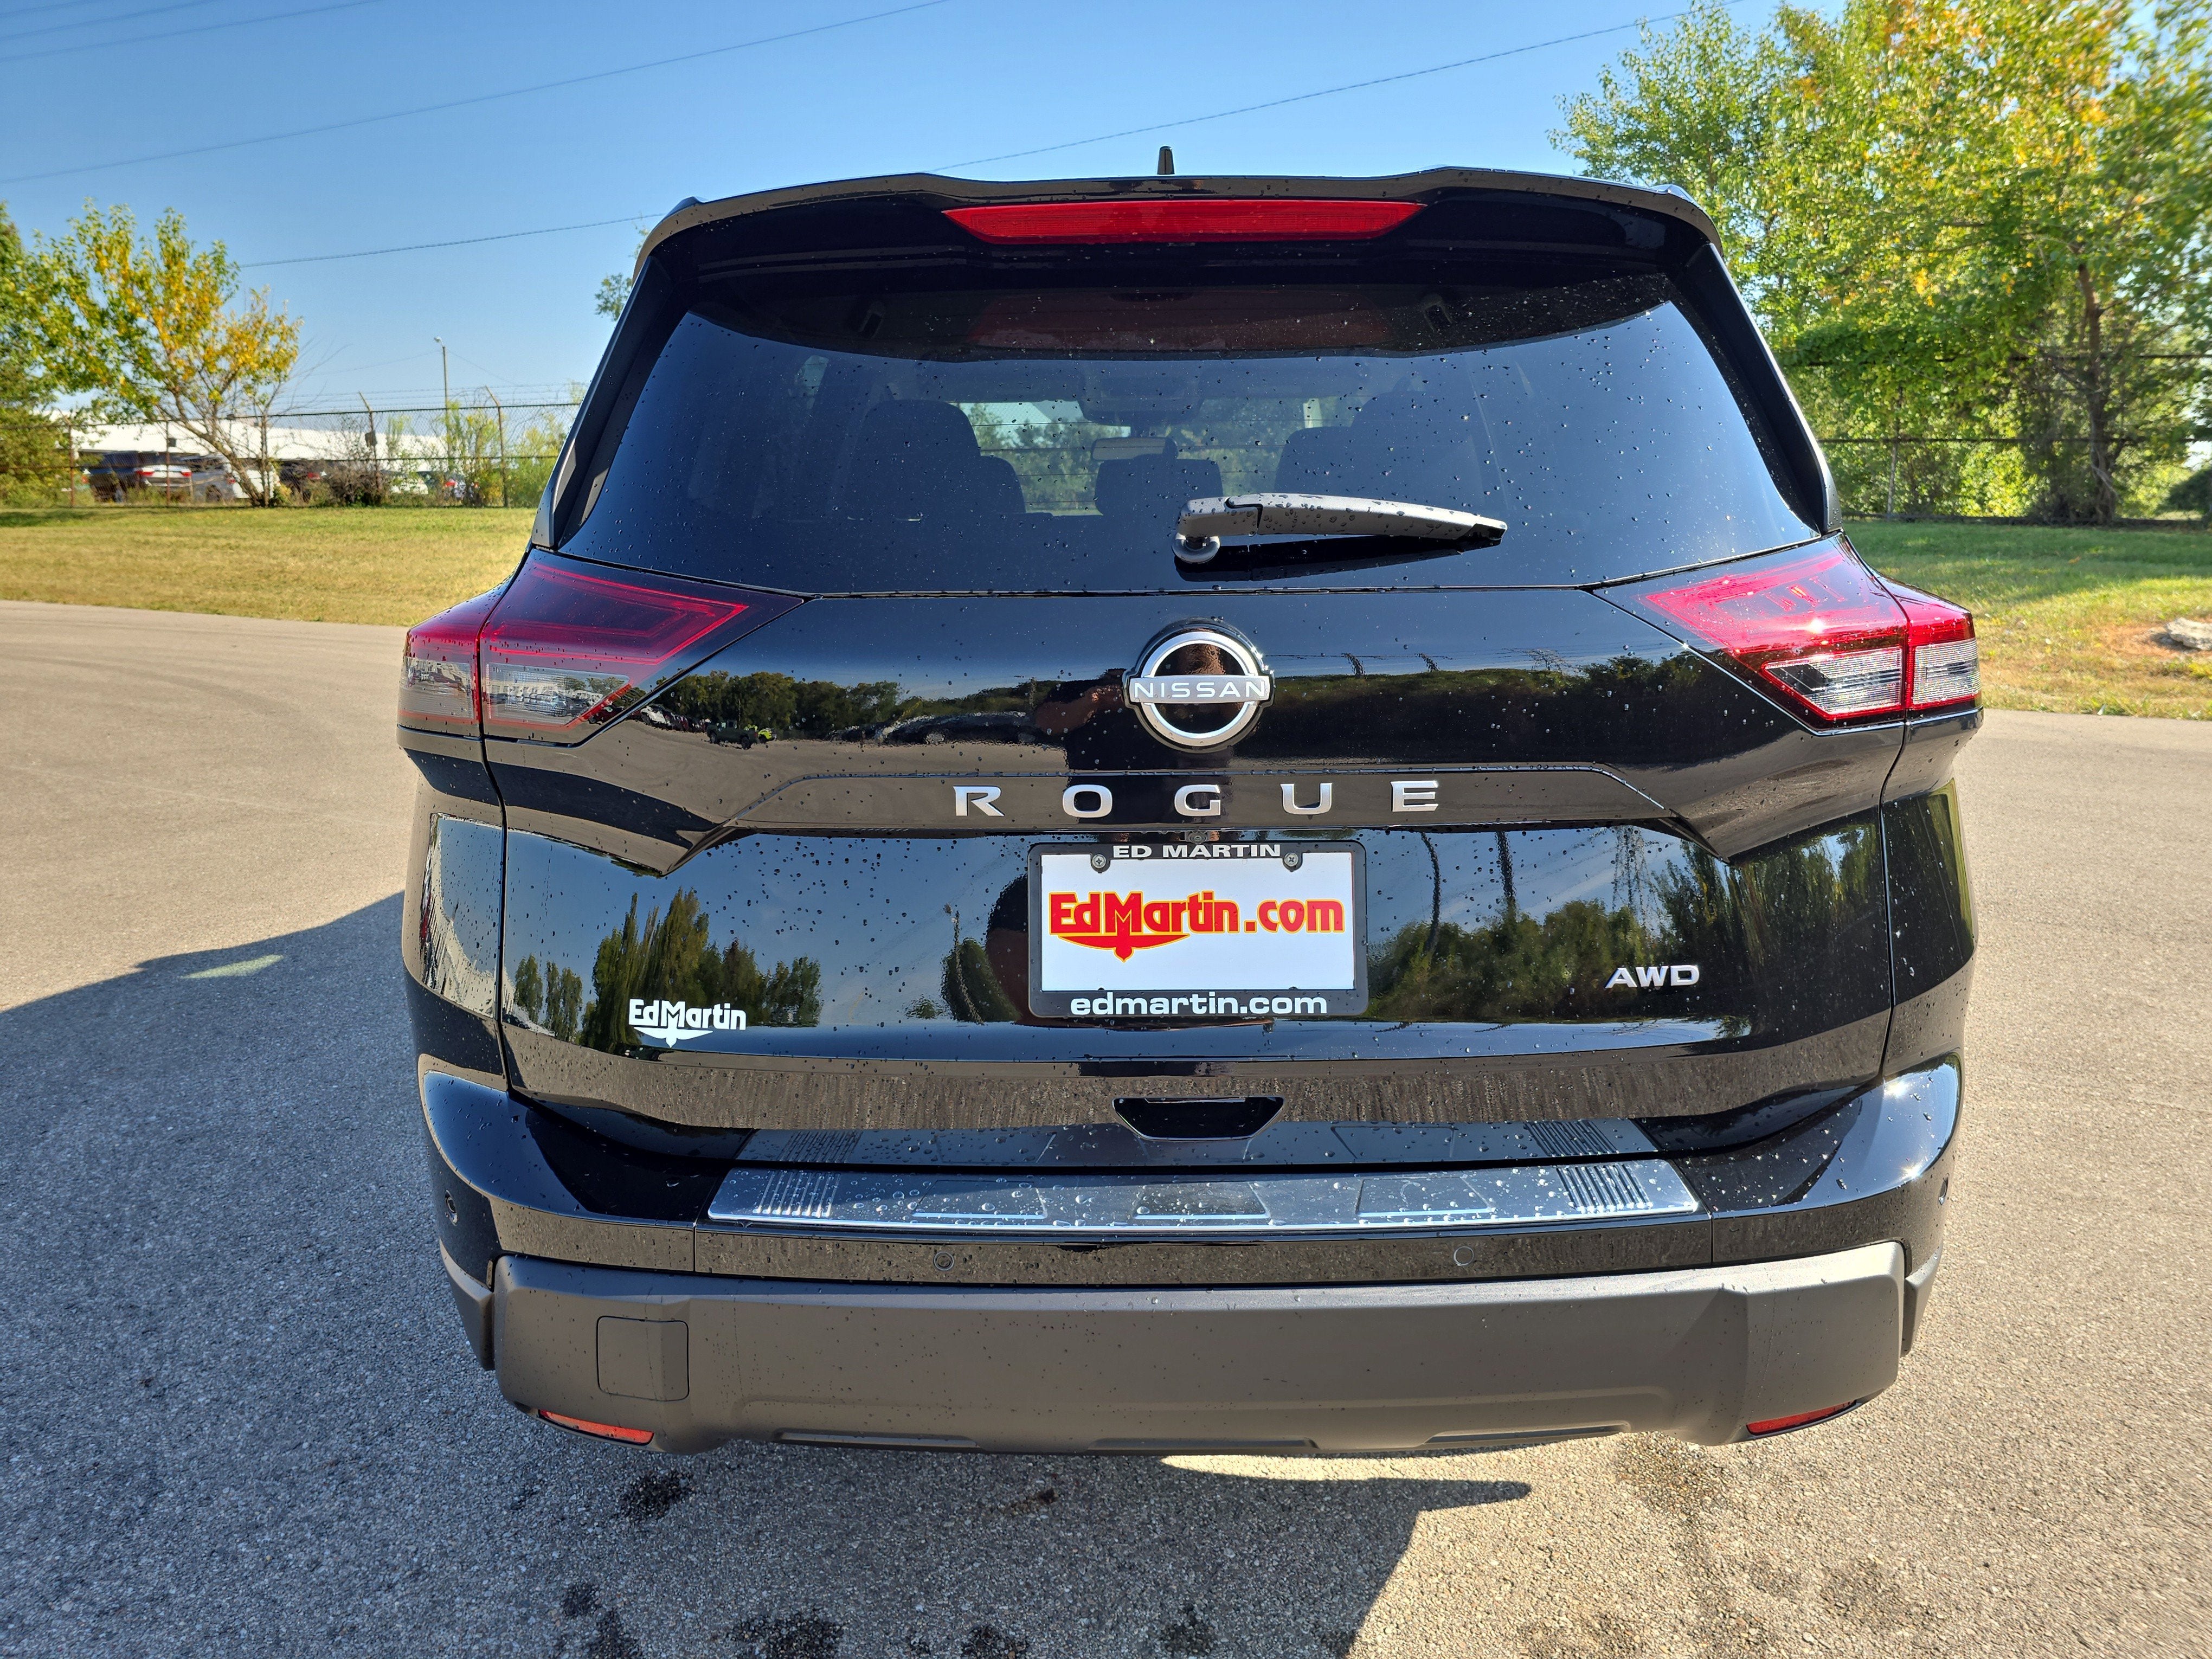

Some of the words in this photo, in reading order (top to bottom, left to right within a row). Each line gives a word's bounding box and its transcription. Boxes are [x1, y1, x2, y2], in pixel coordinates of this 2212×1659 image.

[1134, 681, 1265, 698] NISSAN
[954, 780, 1439, 817] ROGUE
[1113, 845, 1152, 858] ED
[1163, 844, 1281, 858] MARTIN
[1049, 890, 1345, 934] EdMartin.com
[1605, 964, 1700, 988] AWD
[629, 999, 747, 1030] EdMartin
[1070, 992, 1328, 1015] edmartin.com
